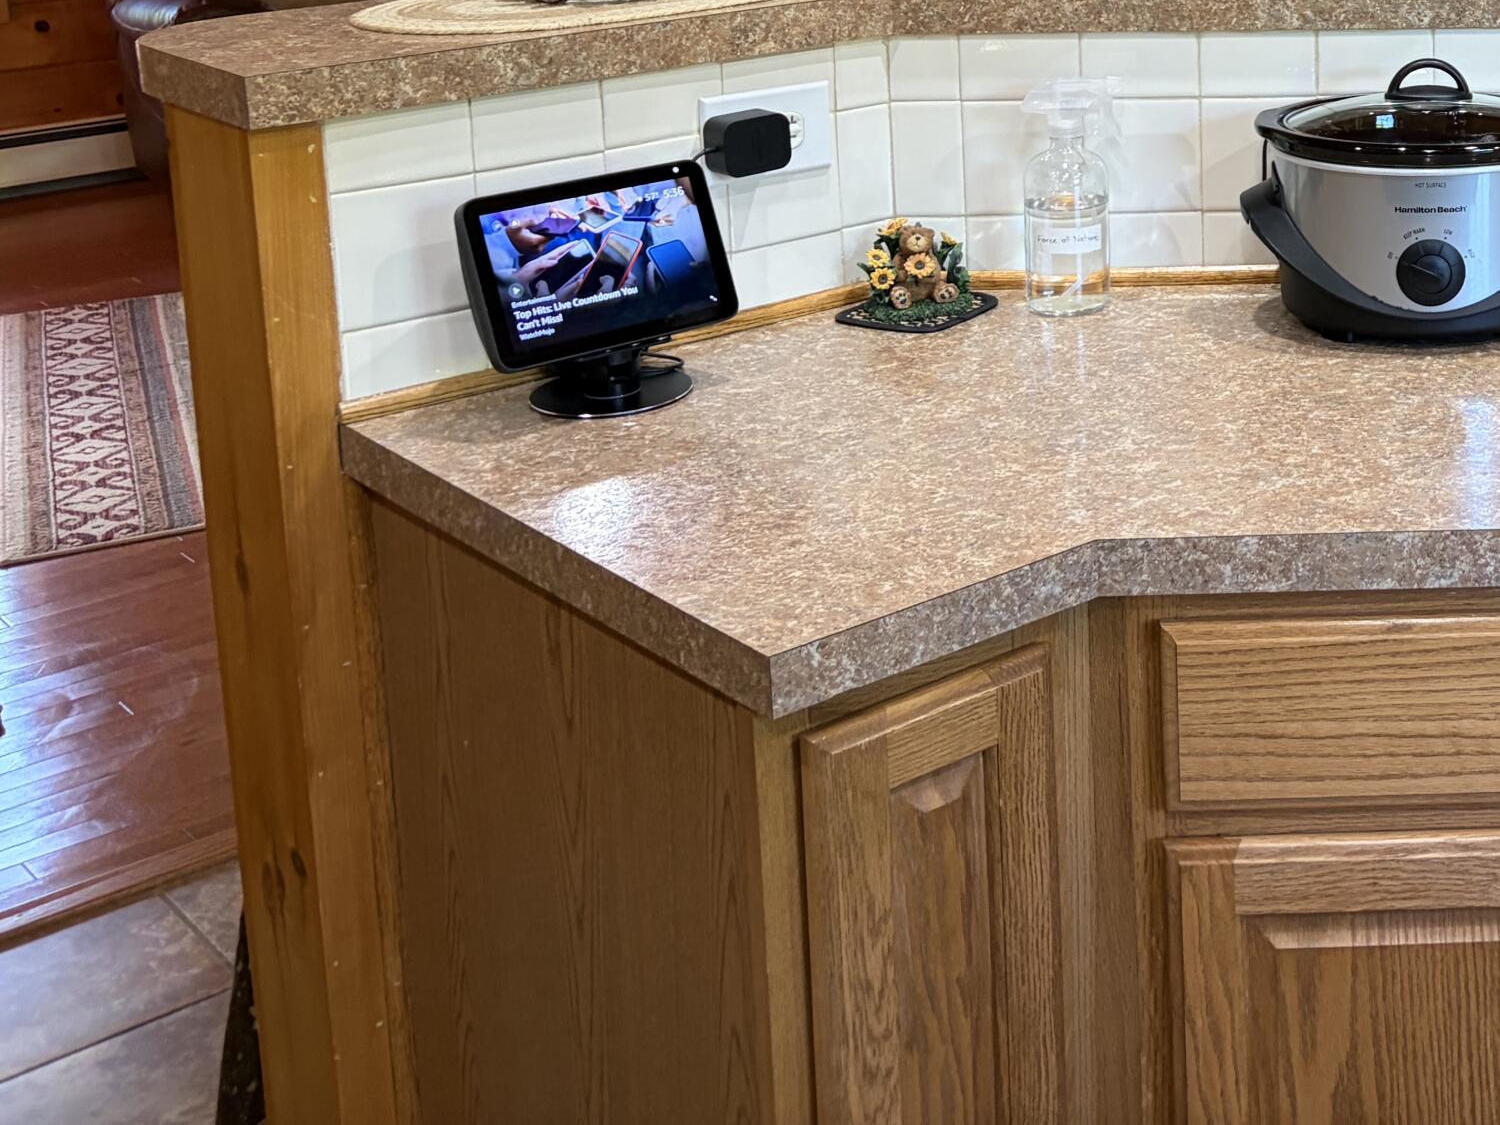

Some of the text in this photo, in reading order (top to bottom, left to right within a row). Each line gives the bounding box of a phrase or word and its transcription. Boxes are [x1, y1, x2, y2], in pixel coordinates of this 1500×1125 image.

[663, 186, 685, 199] 5:36
[1394, 206, 1437, 214] Hamilton
[511, 294, 557, 309] Entertainment
[513, 286, 639, 321] Top Hits: Live Countdown You
[516, 313, 564, 331] Can't Miss!
[518, 327, 556, 341] WatchMojo
